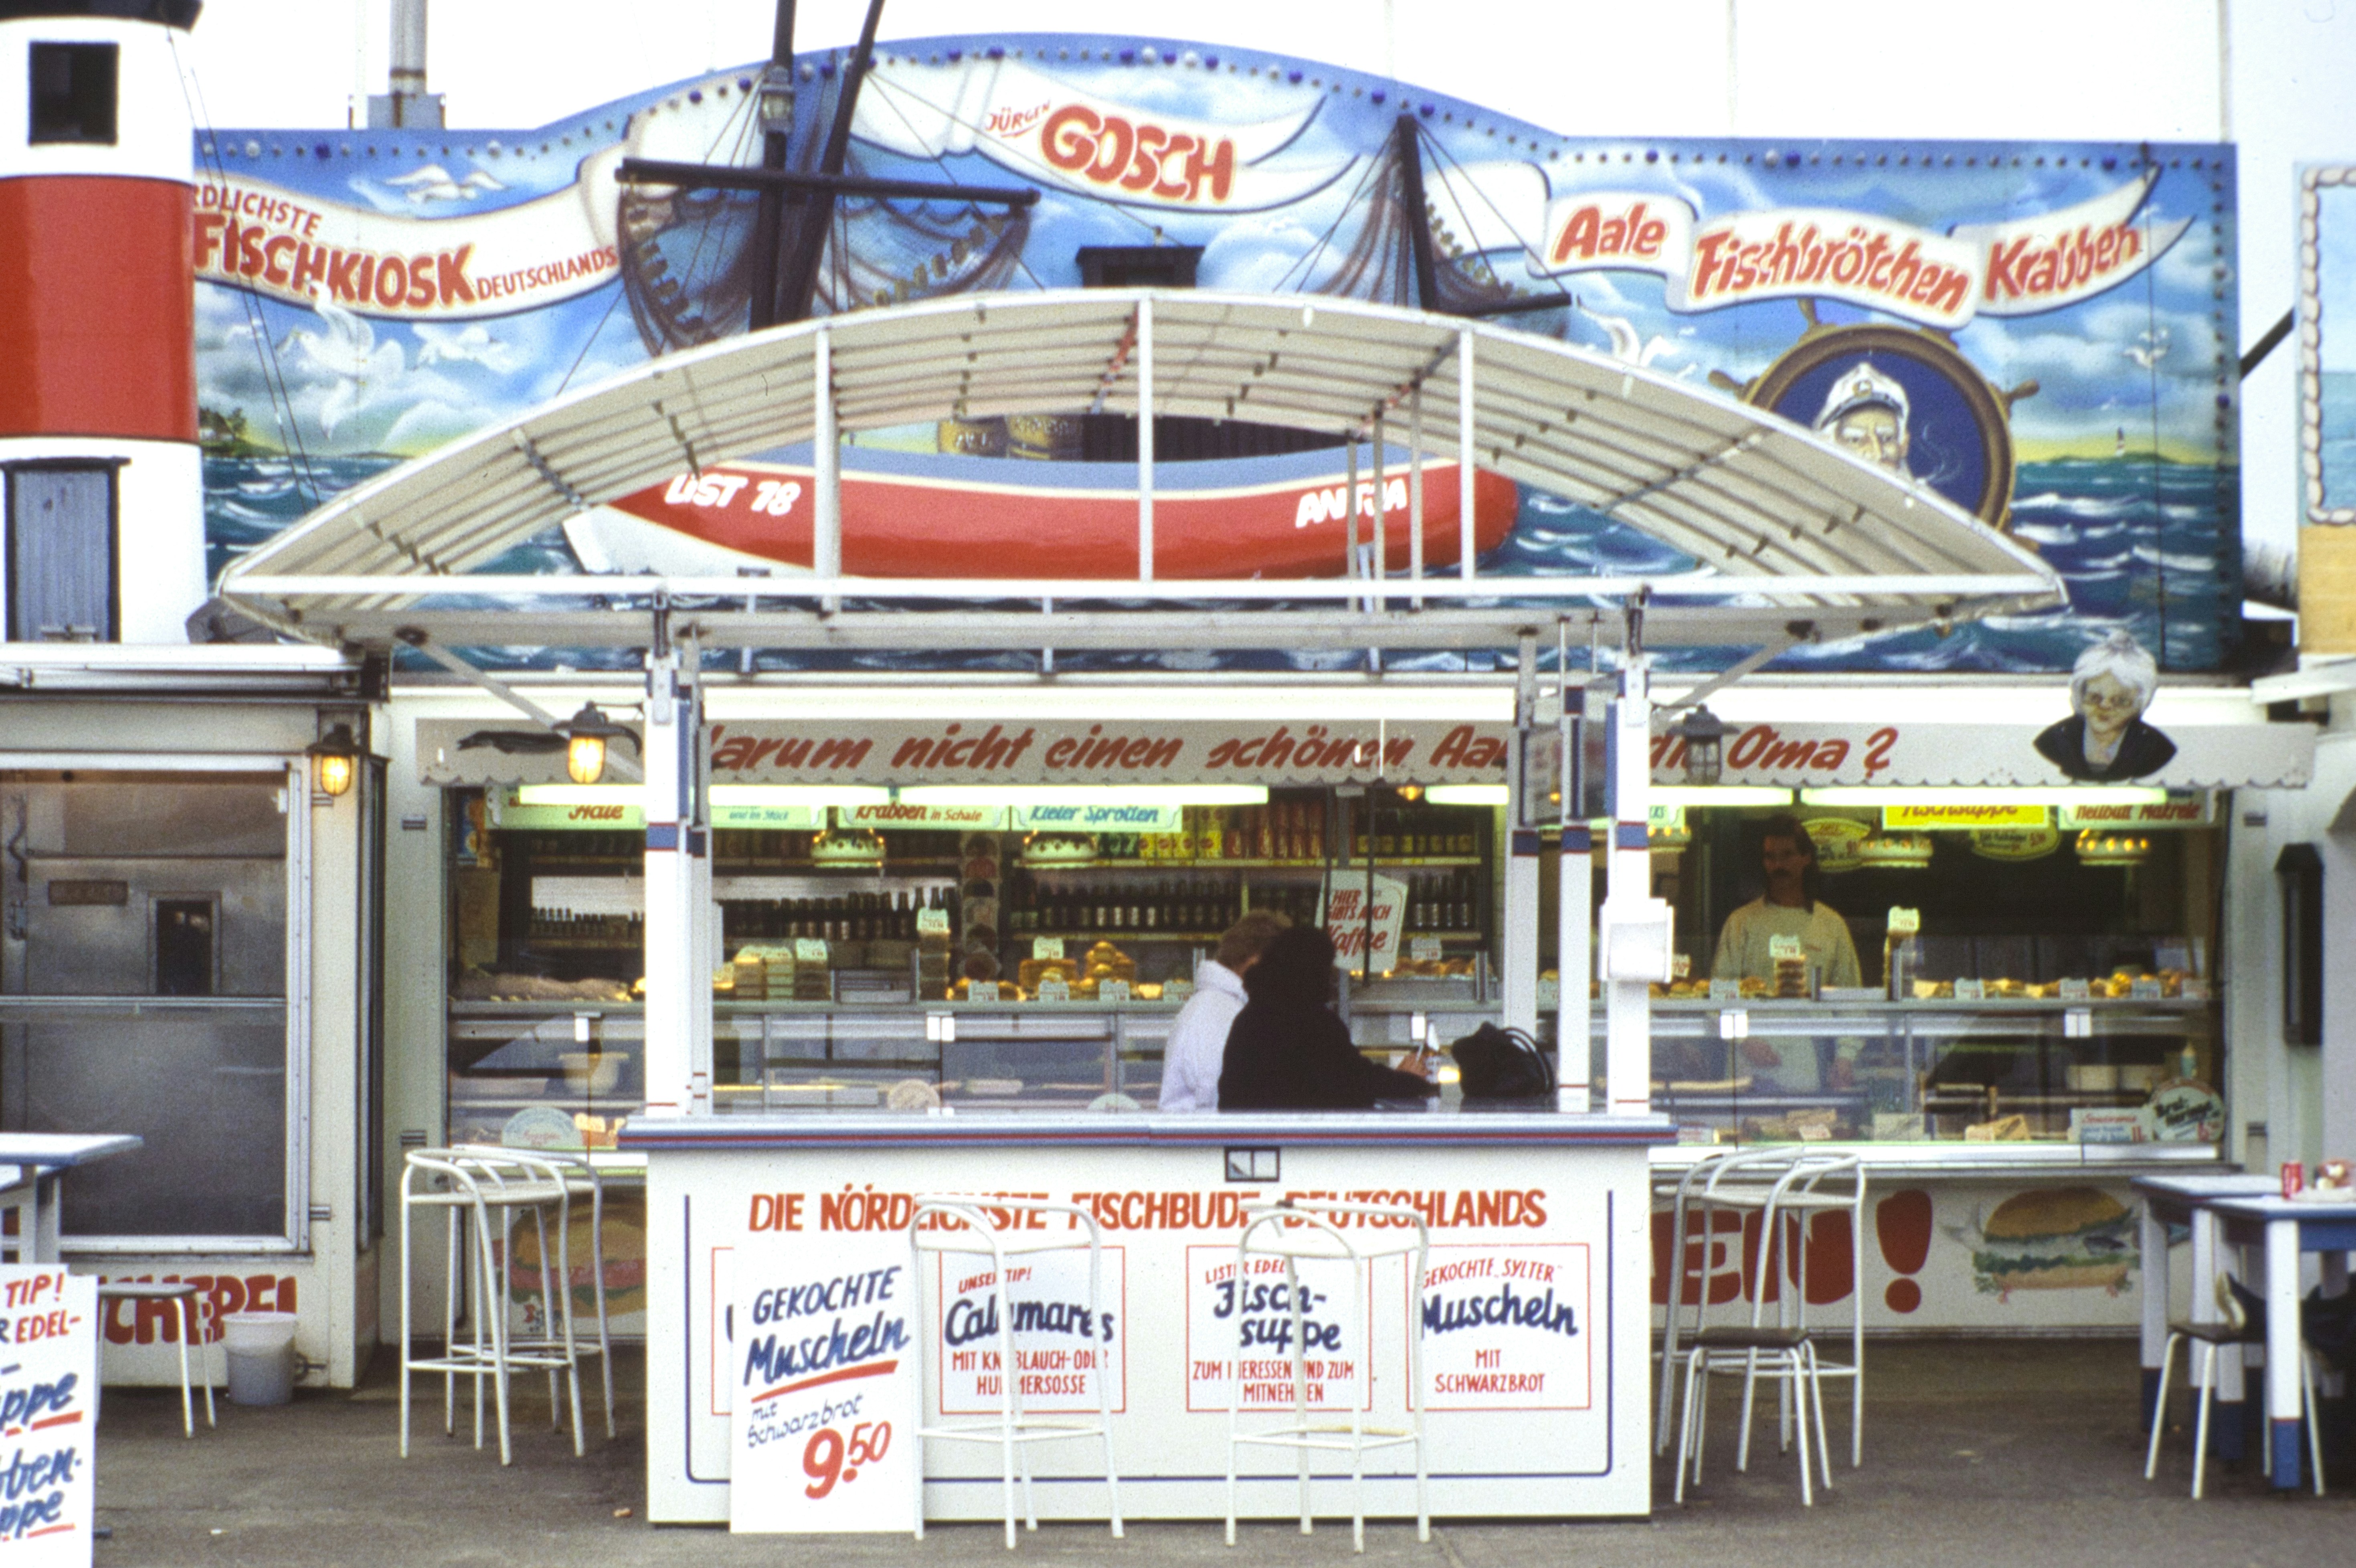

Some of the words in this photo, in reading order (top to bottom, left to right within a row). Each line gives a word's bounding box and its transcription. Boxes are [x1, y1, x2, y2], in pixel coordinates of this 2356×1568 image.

[1041, 105, 1234, 202] GOSCH
[1554, 203, 1668, 264] Aale
[194, 213, 476, 308] FISCHKIOSK
[477, 245, 618, 300] DEUTSCHLANDS
[1691, 227, 1969, 314] Fischbrötchen
[1982, 221, 2143, 301] Krabben
[890, 723, 1036, 770] nicht
[1045, 723, 1183, 769] einen
[1205, 724, 1415, 769] schönen
[1727, 724, 1850, 771] Oma
[748, 1192, 804, 1232] DIE
[5, 1272, 65, 1309] TIP!
[1004, 1266, 1032, 1283] TIP!
[1205, 1261, 1249, 1284] LISTR
[95, 1275, 297, 1345] CHEREI
[753, 1265, 902, 1325] GEKOCHTE
[15, 1308, 82, 1344] EDEL-
[742, 1309, 912, 1387] Muscheln
[951, 1350, 977, 1371] MIT
[1193, 1360, 1223, 1380] ZUM
[1328, 1360, 1354, 1380] ZUM
[1476, 1349, 1502, 1368] MIT
[1244, 1383, 1324, 1402] MITNEHEN
[1435, 1373, 1545, 1393] SCHWARZBROT
[802, 1420, 893, 1501] 9.50
